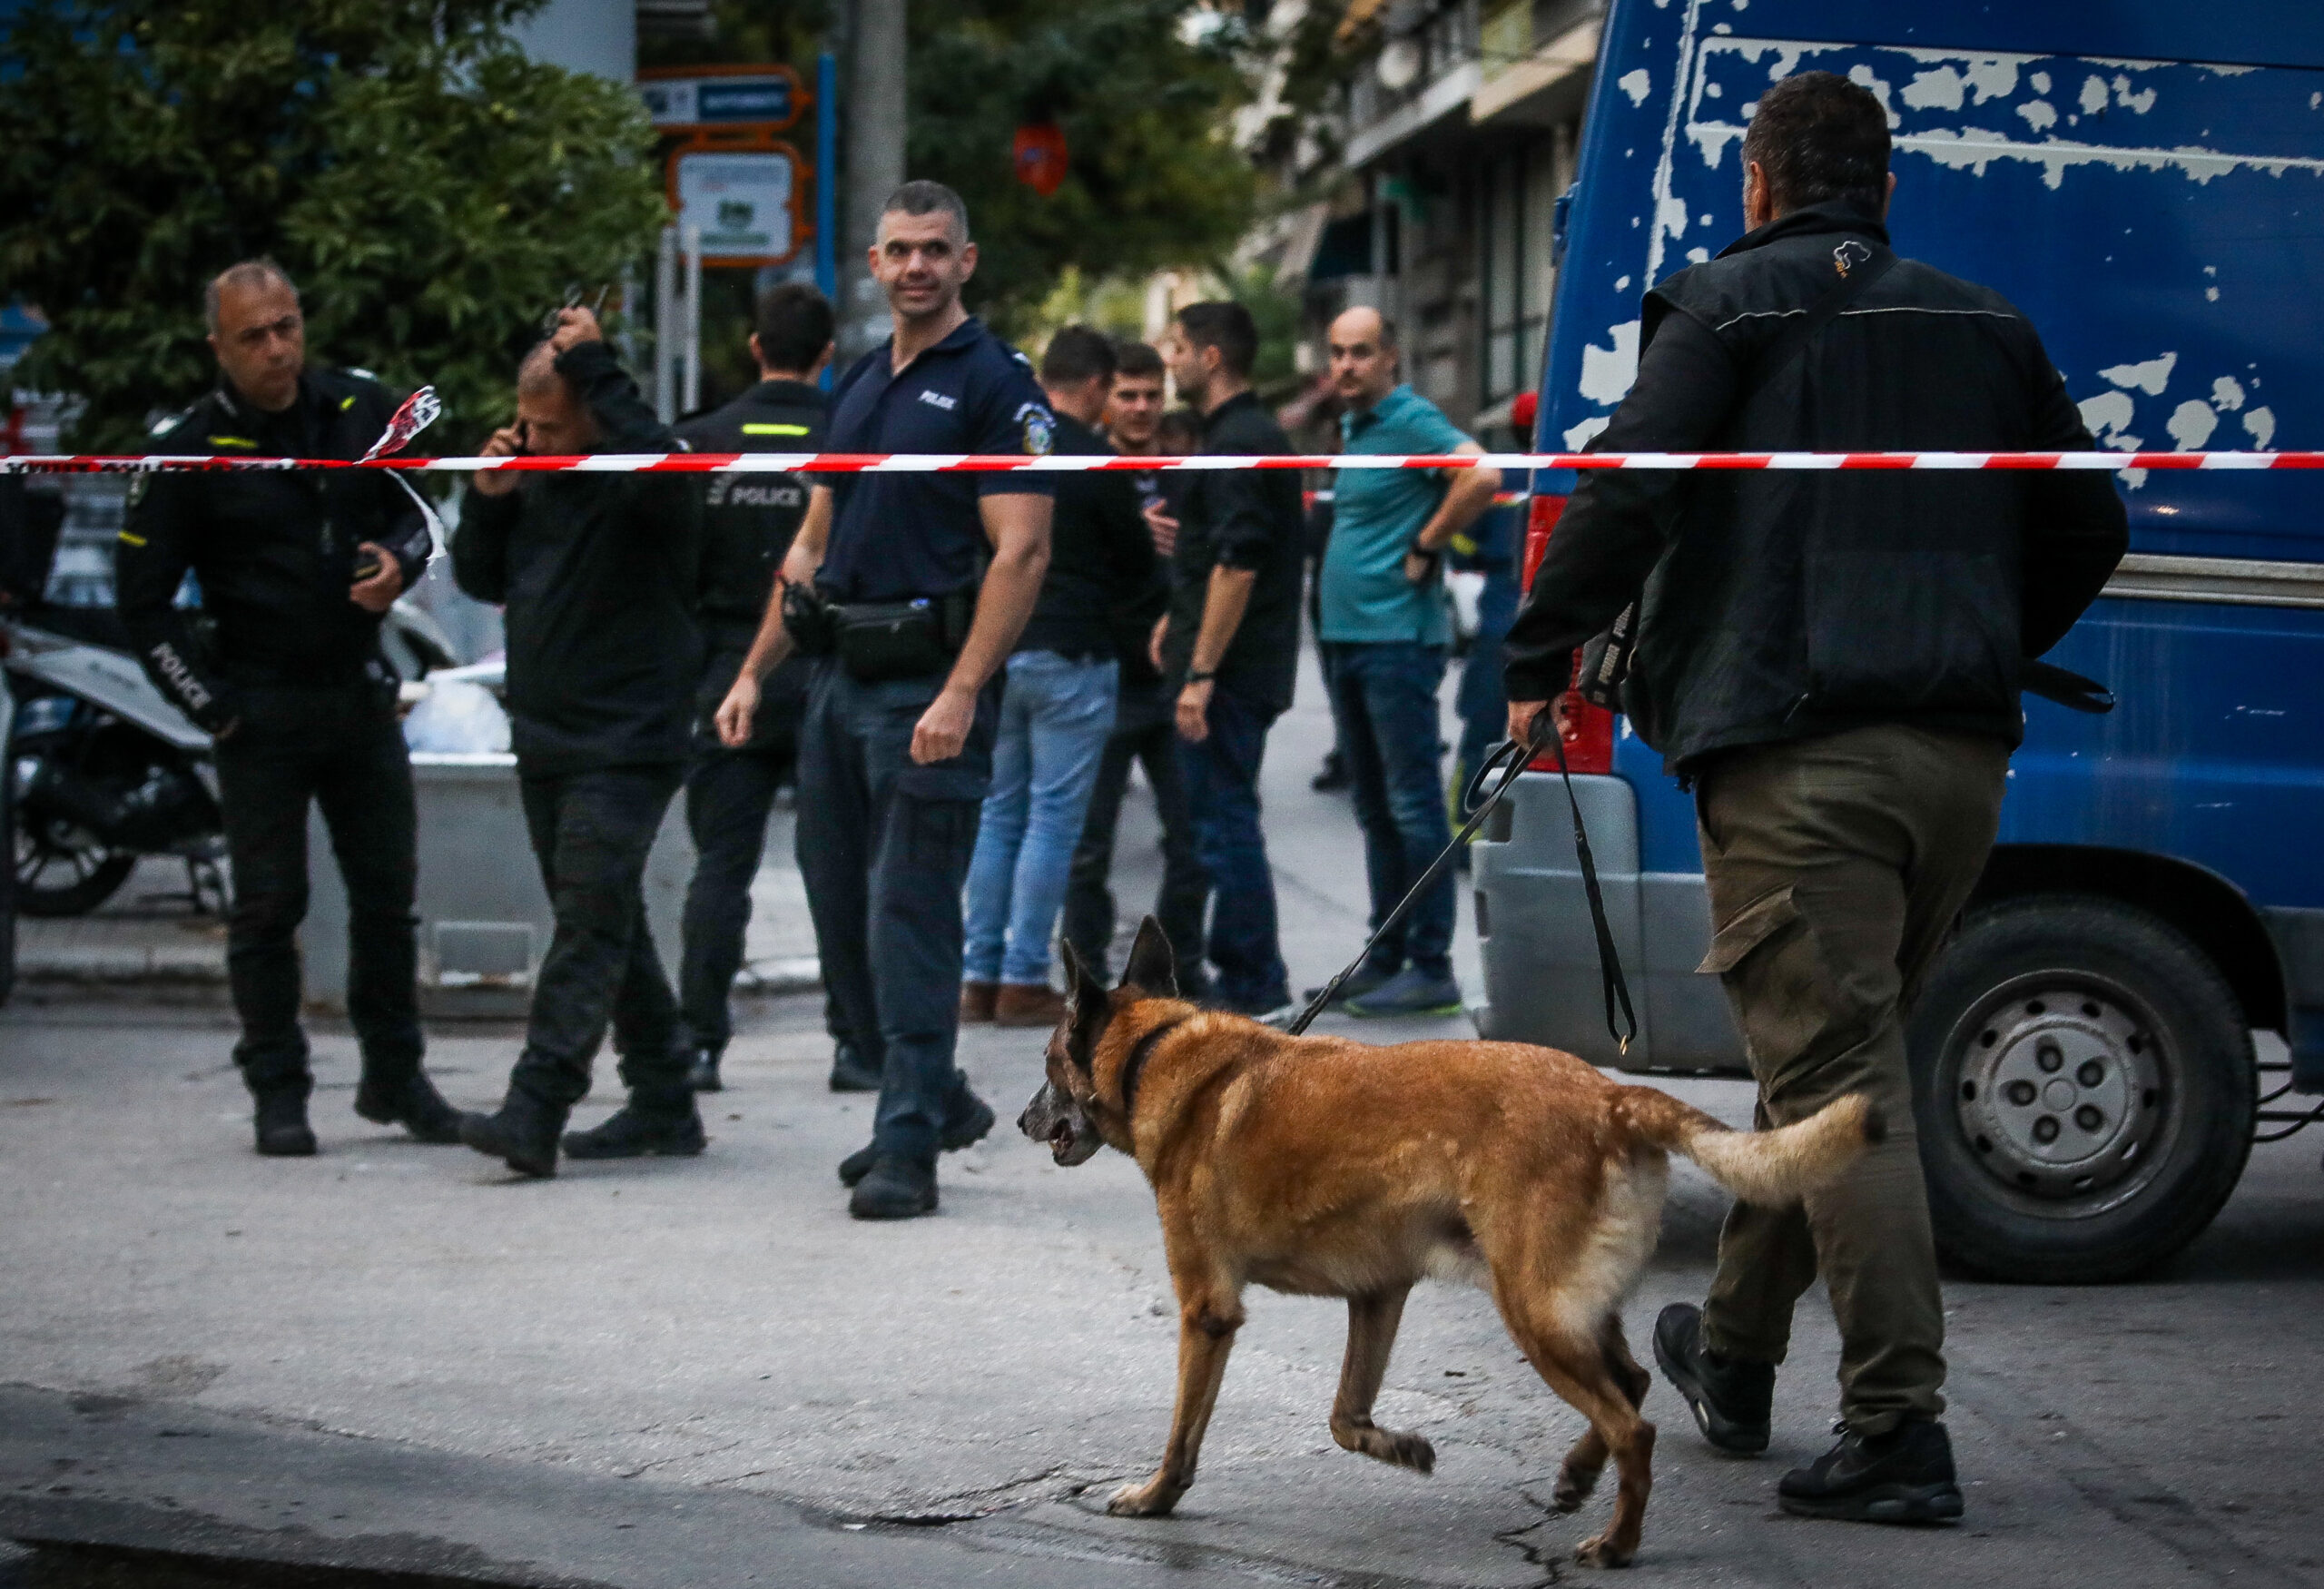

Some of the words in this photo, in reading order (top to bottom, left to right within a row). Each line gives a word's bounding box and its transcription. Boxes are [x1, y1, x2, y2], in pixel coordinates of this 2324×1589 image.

[919, 390, 957, 409] POLICE
[732, 487, 800, 505] POLICE
[151, 642, 211, 708] POLICE
